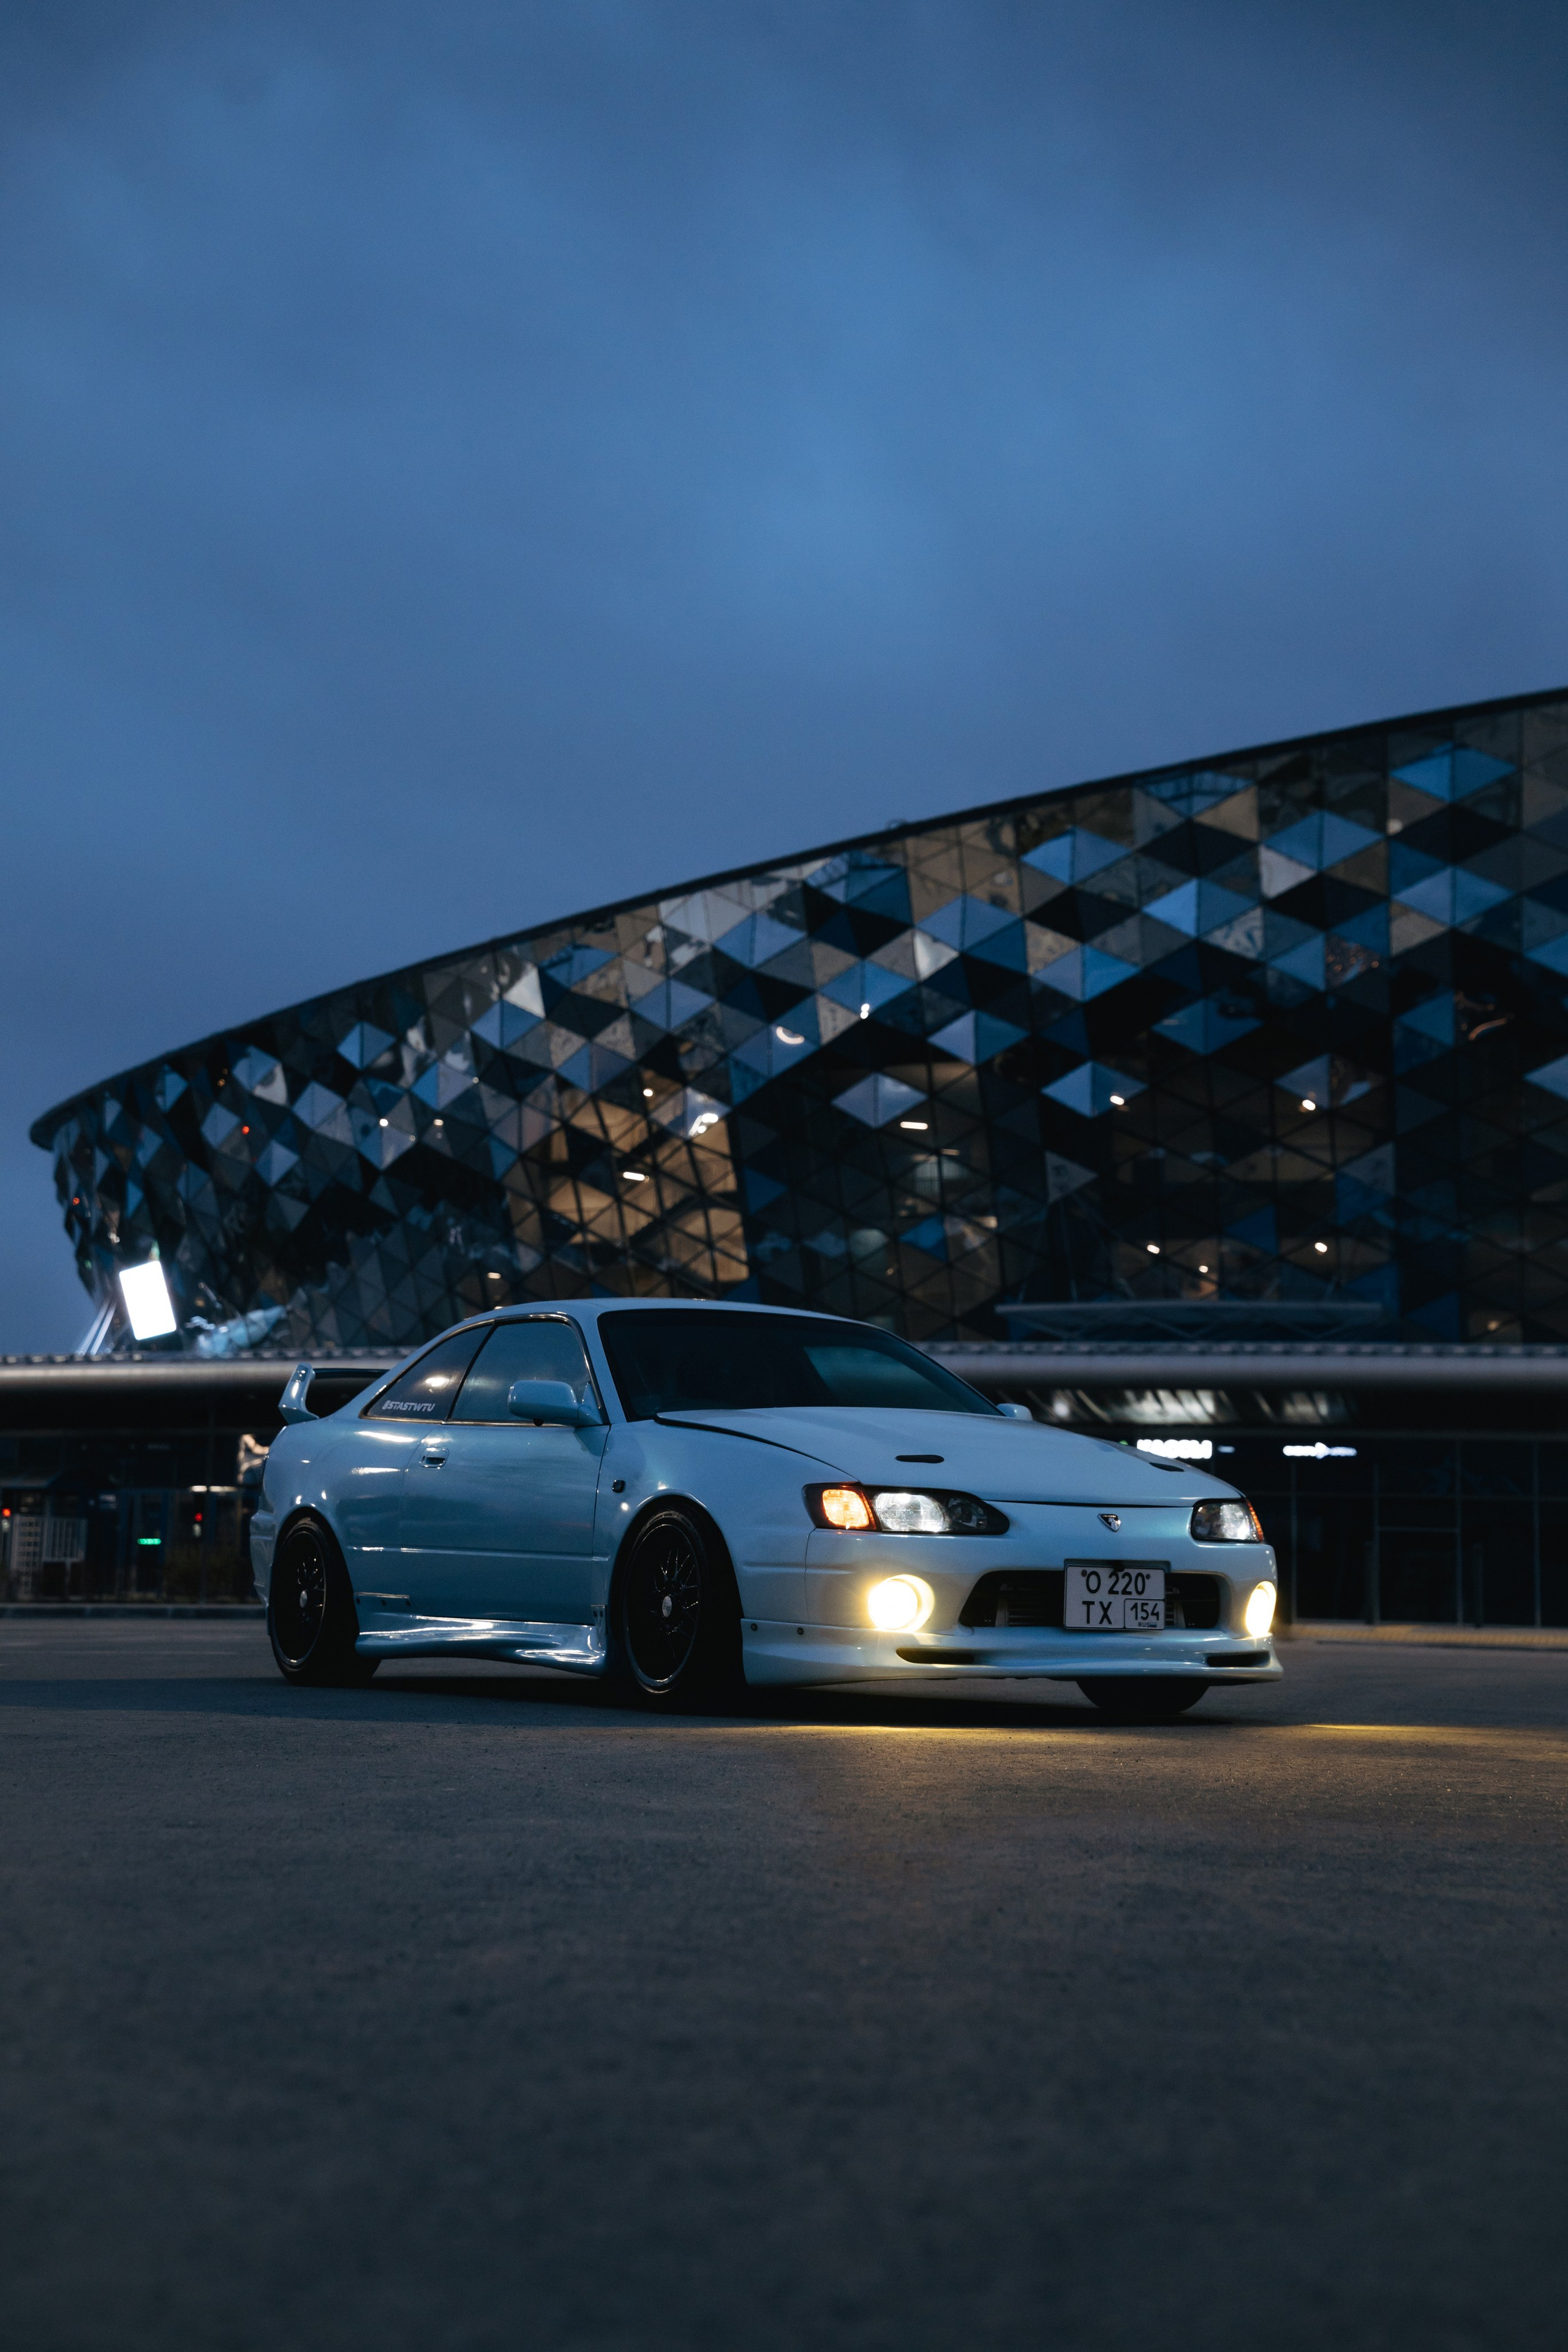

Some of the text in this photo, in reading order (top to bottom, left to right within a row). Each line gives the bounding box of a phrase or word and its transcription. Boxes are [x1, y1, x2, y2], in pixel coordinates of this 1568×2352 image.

[1086, 1570, 1146, 1596] O 220
[1082, 1600, 1112, 1624] TX
[1130, 1602, 1159, 1621] 154
